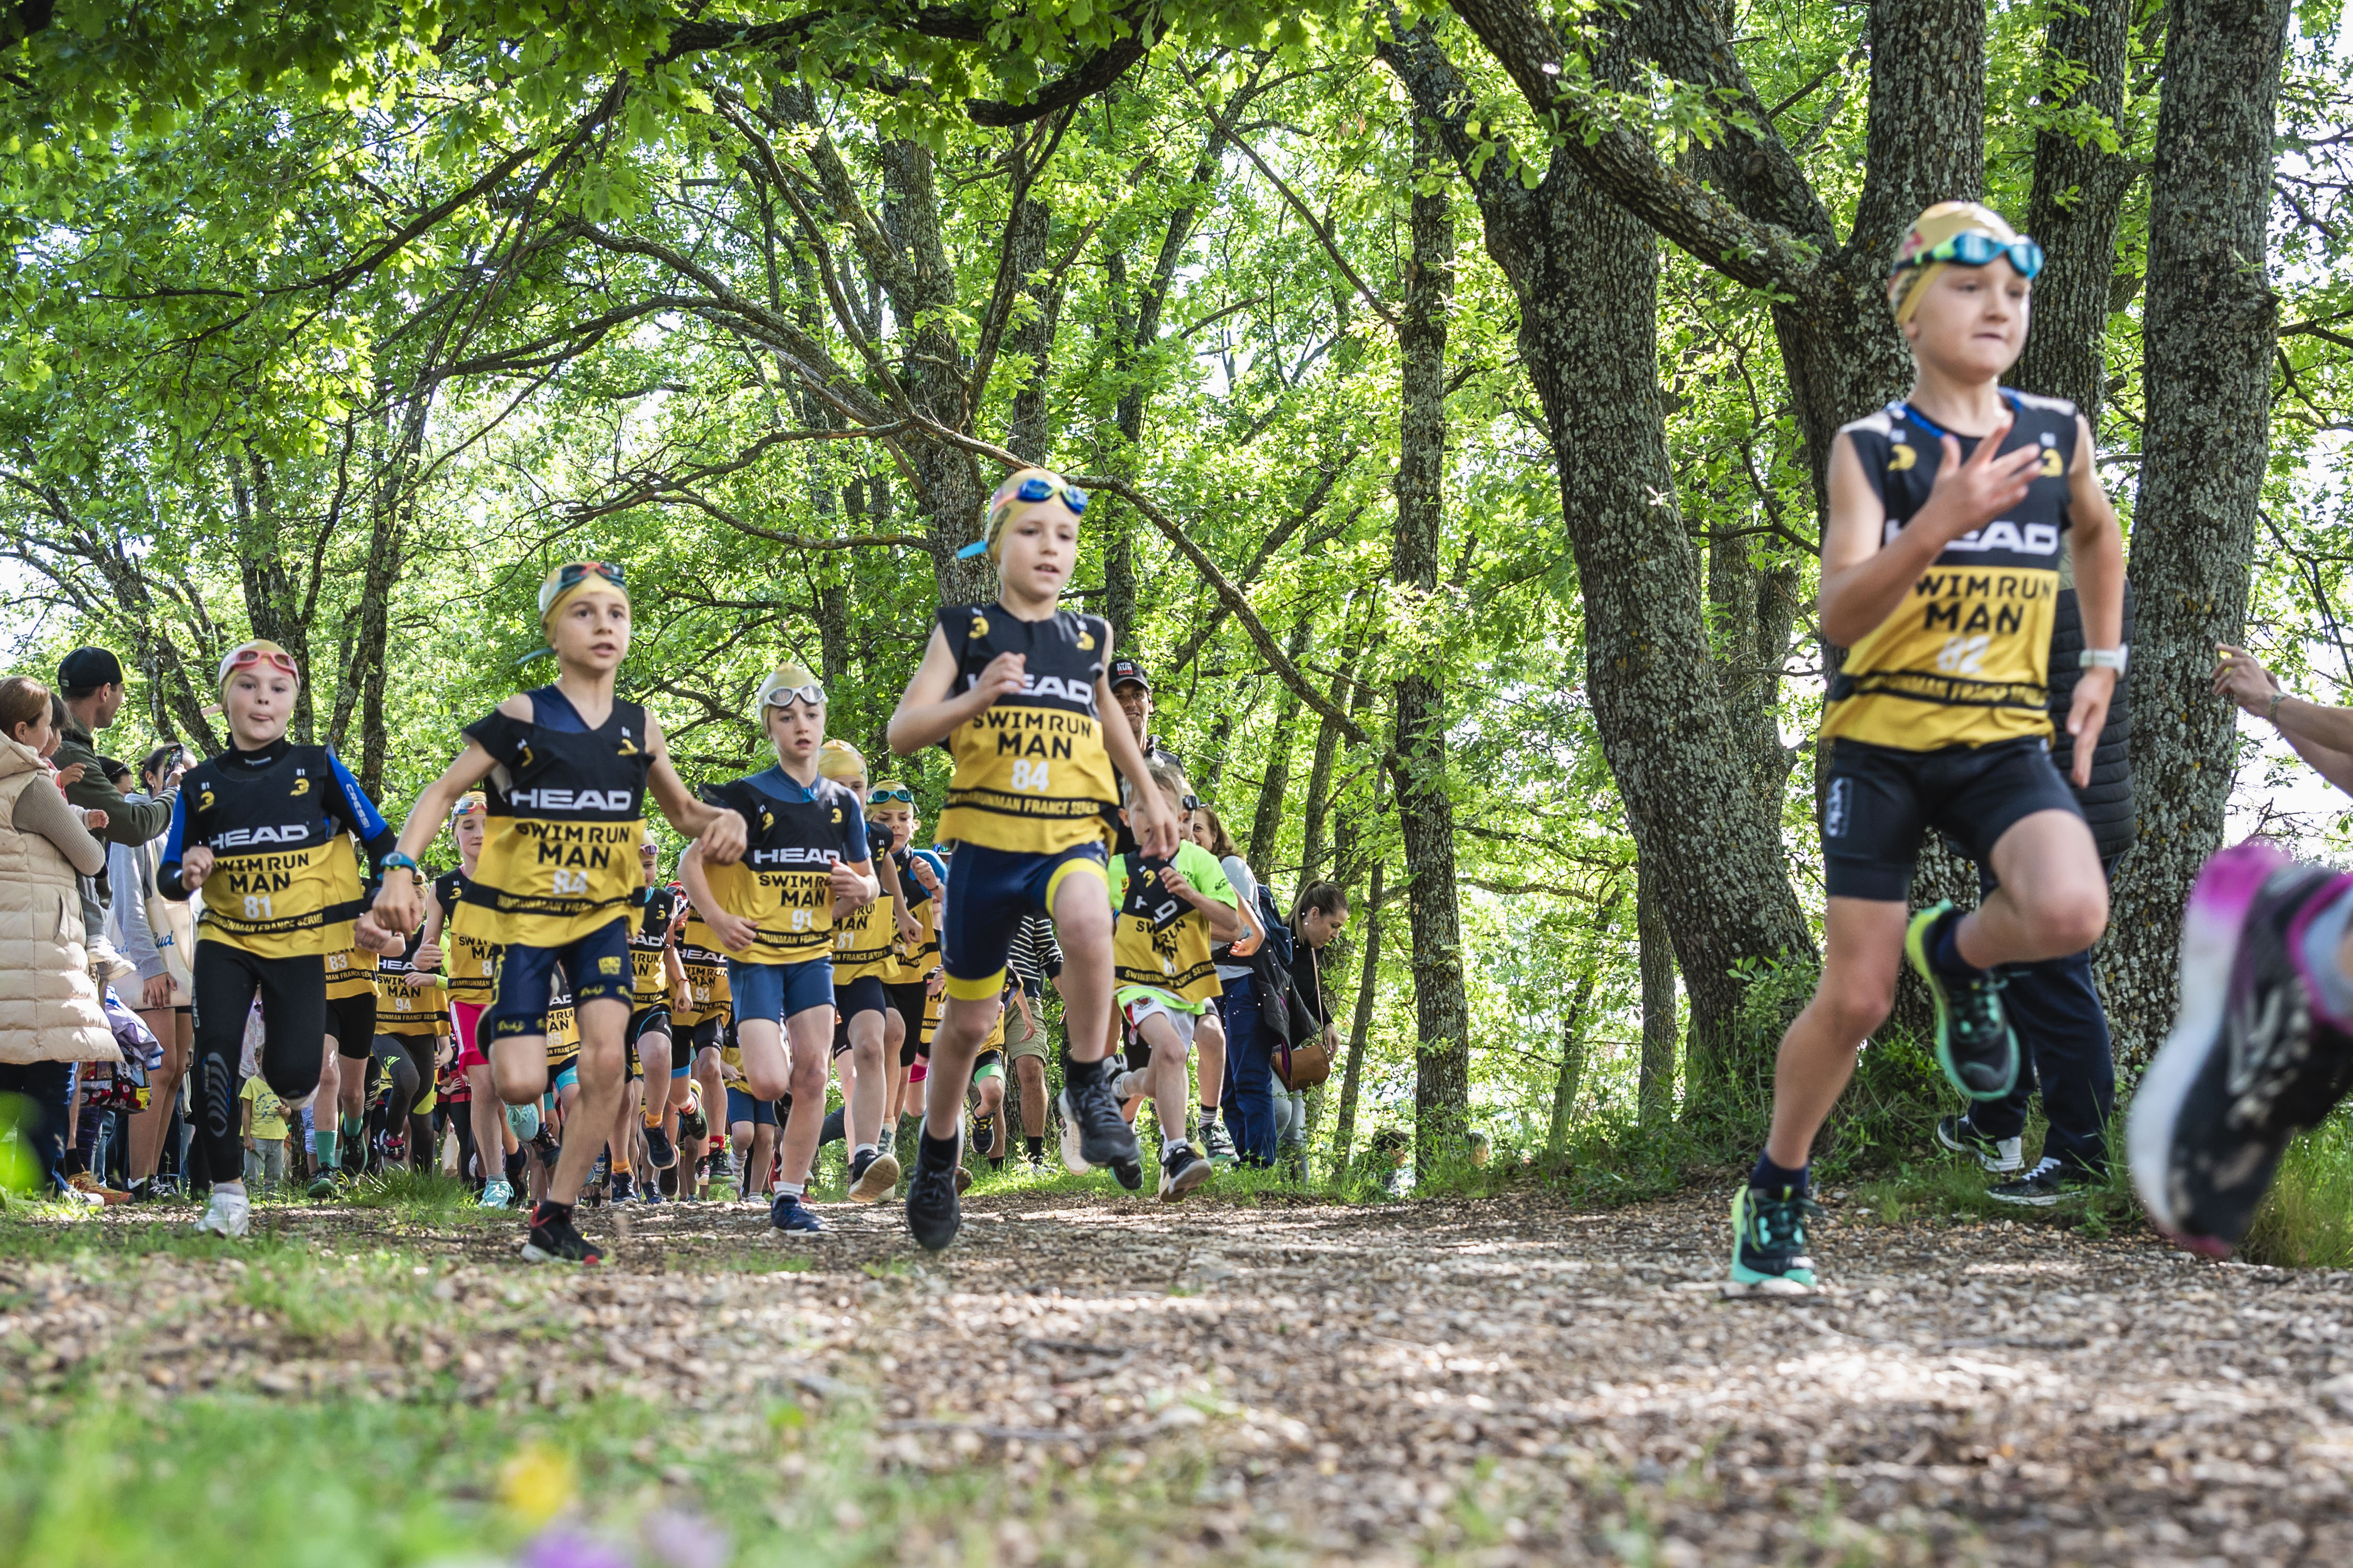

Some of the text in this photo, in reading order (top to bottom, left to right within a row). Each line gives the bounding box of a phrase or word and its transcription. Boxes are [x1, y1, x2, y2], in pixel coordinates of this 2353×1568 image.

[1885, 520, 2059, 556] AD
[1915, 575, 2054, 600] WIMRUN
[1924, 601, 2024, 634] MAN
[973, 711, 1092, 738] SWIMRUN
[998, 731, 1071, 759] MAN
[1011, 759, 1049, 792] 84
[346, 783, 370, 829] CRESSI
[510, 788, 632, 810] HEAD
[515, 821, 630, 843] SWIMRUN
[538, 841, 610, 868] MAN
[754, 848, 840, 864] HEAD
[229, 872, 290, 893] MAN
[759, 874, 832, 888] SWIMR
[781, 889, 825, 907] MAN
[244, 895, 272, 919] 81
[792, 909, 813, 931] 91
[632, 934, 663, 947] AD
[837, 932, 854, 949] 81
[328, 954, 348, 970] 83
[379, 959, 418, 970] HEA
[482, 960, 493, 976] 8
[377, 976, 406, 985] SWIM
[688, 974, 716, 988] MAN
[388, 986, 421, 998] MAN
[395, 998, 412, 1011] 94
[936, 1004, 945, 1017] 8
[549, 1020, 569, 1032] AN
[546, 1032, 562, 1046] 85
